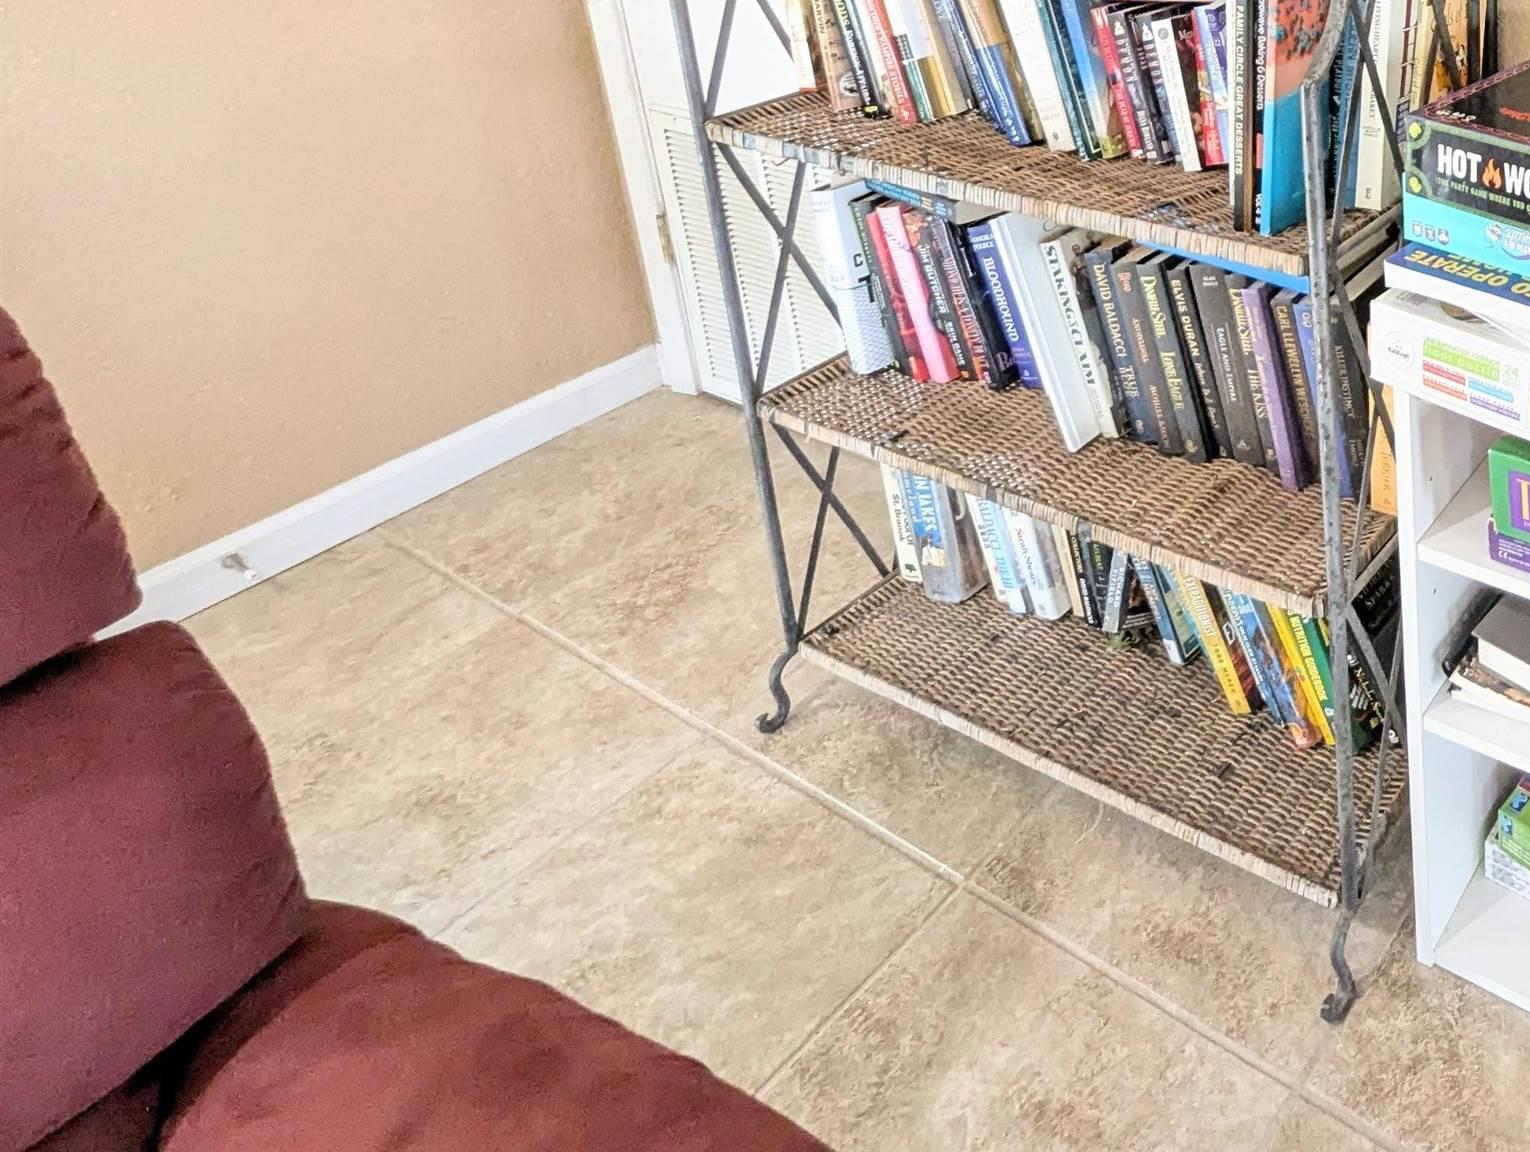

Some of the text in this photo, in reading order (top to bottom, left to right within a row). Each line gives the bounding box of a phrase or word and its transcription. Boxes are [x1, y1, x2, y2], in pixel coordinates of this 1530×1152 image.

[1255, 35, 1265, 64] Baking
[1256, 74, 1265, 110] Desserts
[1234, 122, 1242, 174] DESSERTS
[1438, 144, 1482, 183] HOT
[1451, 182, 1469, 194] PARTY
[1471, 187, 1488, 199] GAME
[1489, 191, 1511, 207] WHERE
[1513, 199, 1525, 210] YOU
[916, 244, 948, 314] JIM BUTCHER
[1403, 245, 1508, 290] OPERATE
[982, 255, 1020, 343] BLOODHOUND
[1092, 262, 1129, 358] DAVID BALDACCI
[1170, 278, 1200, 357] ELVIS DURAN
[945, 320, 966, 366] SKIN GAME
[1216, 327, 1237, 402] EAGLE AND EMPIRE
[1275, 304, 1305, 388] CARL LLEWELLYN
[1121, 364, 1143, 398] TRUE
[1159, 348, 1189, 411] LONE EAGLE
[1333, 344, 1355, 417] KILLER INSTINCT
[1251, 391, 1270, 419] KISS
[1287, 614, 1314, 657] NUTRITION
